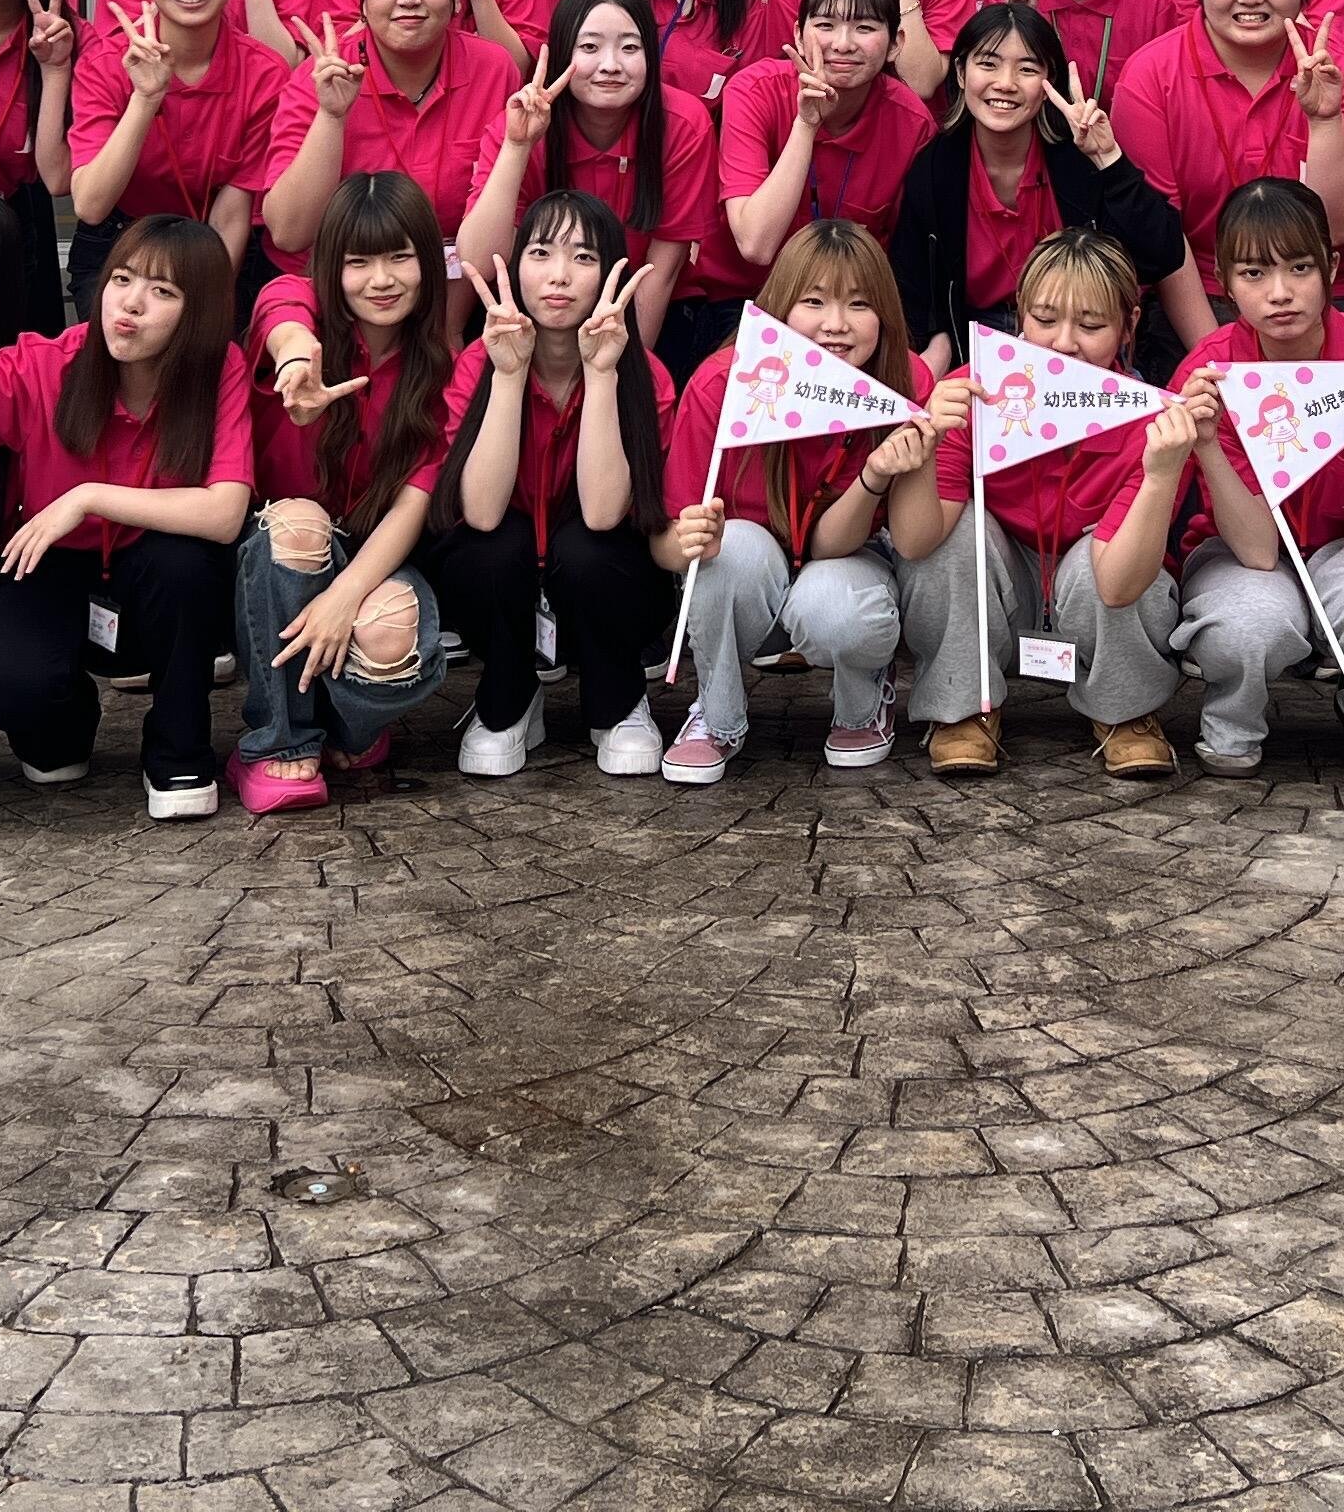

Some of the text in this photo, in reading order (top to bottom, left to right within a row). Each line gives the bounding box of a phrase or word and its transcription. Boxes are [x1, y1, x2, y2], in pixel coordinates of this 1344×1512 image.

[793, 380, 896, 416] 幼児教育学科
[1043, 390, 1149, 409] 幼児教育学科
